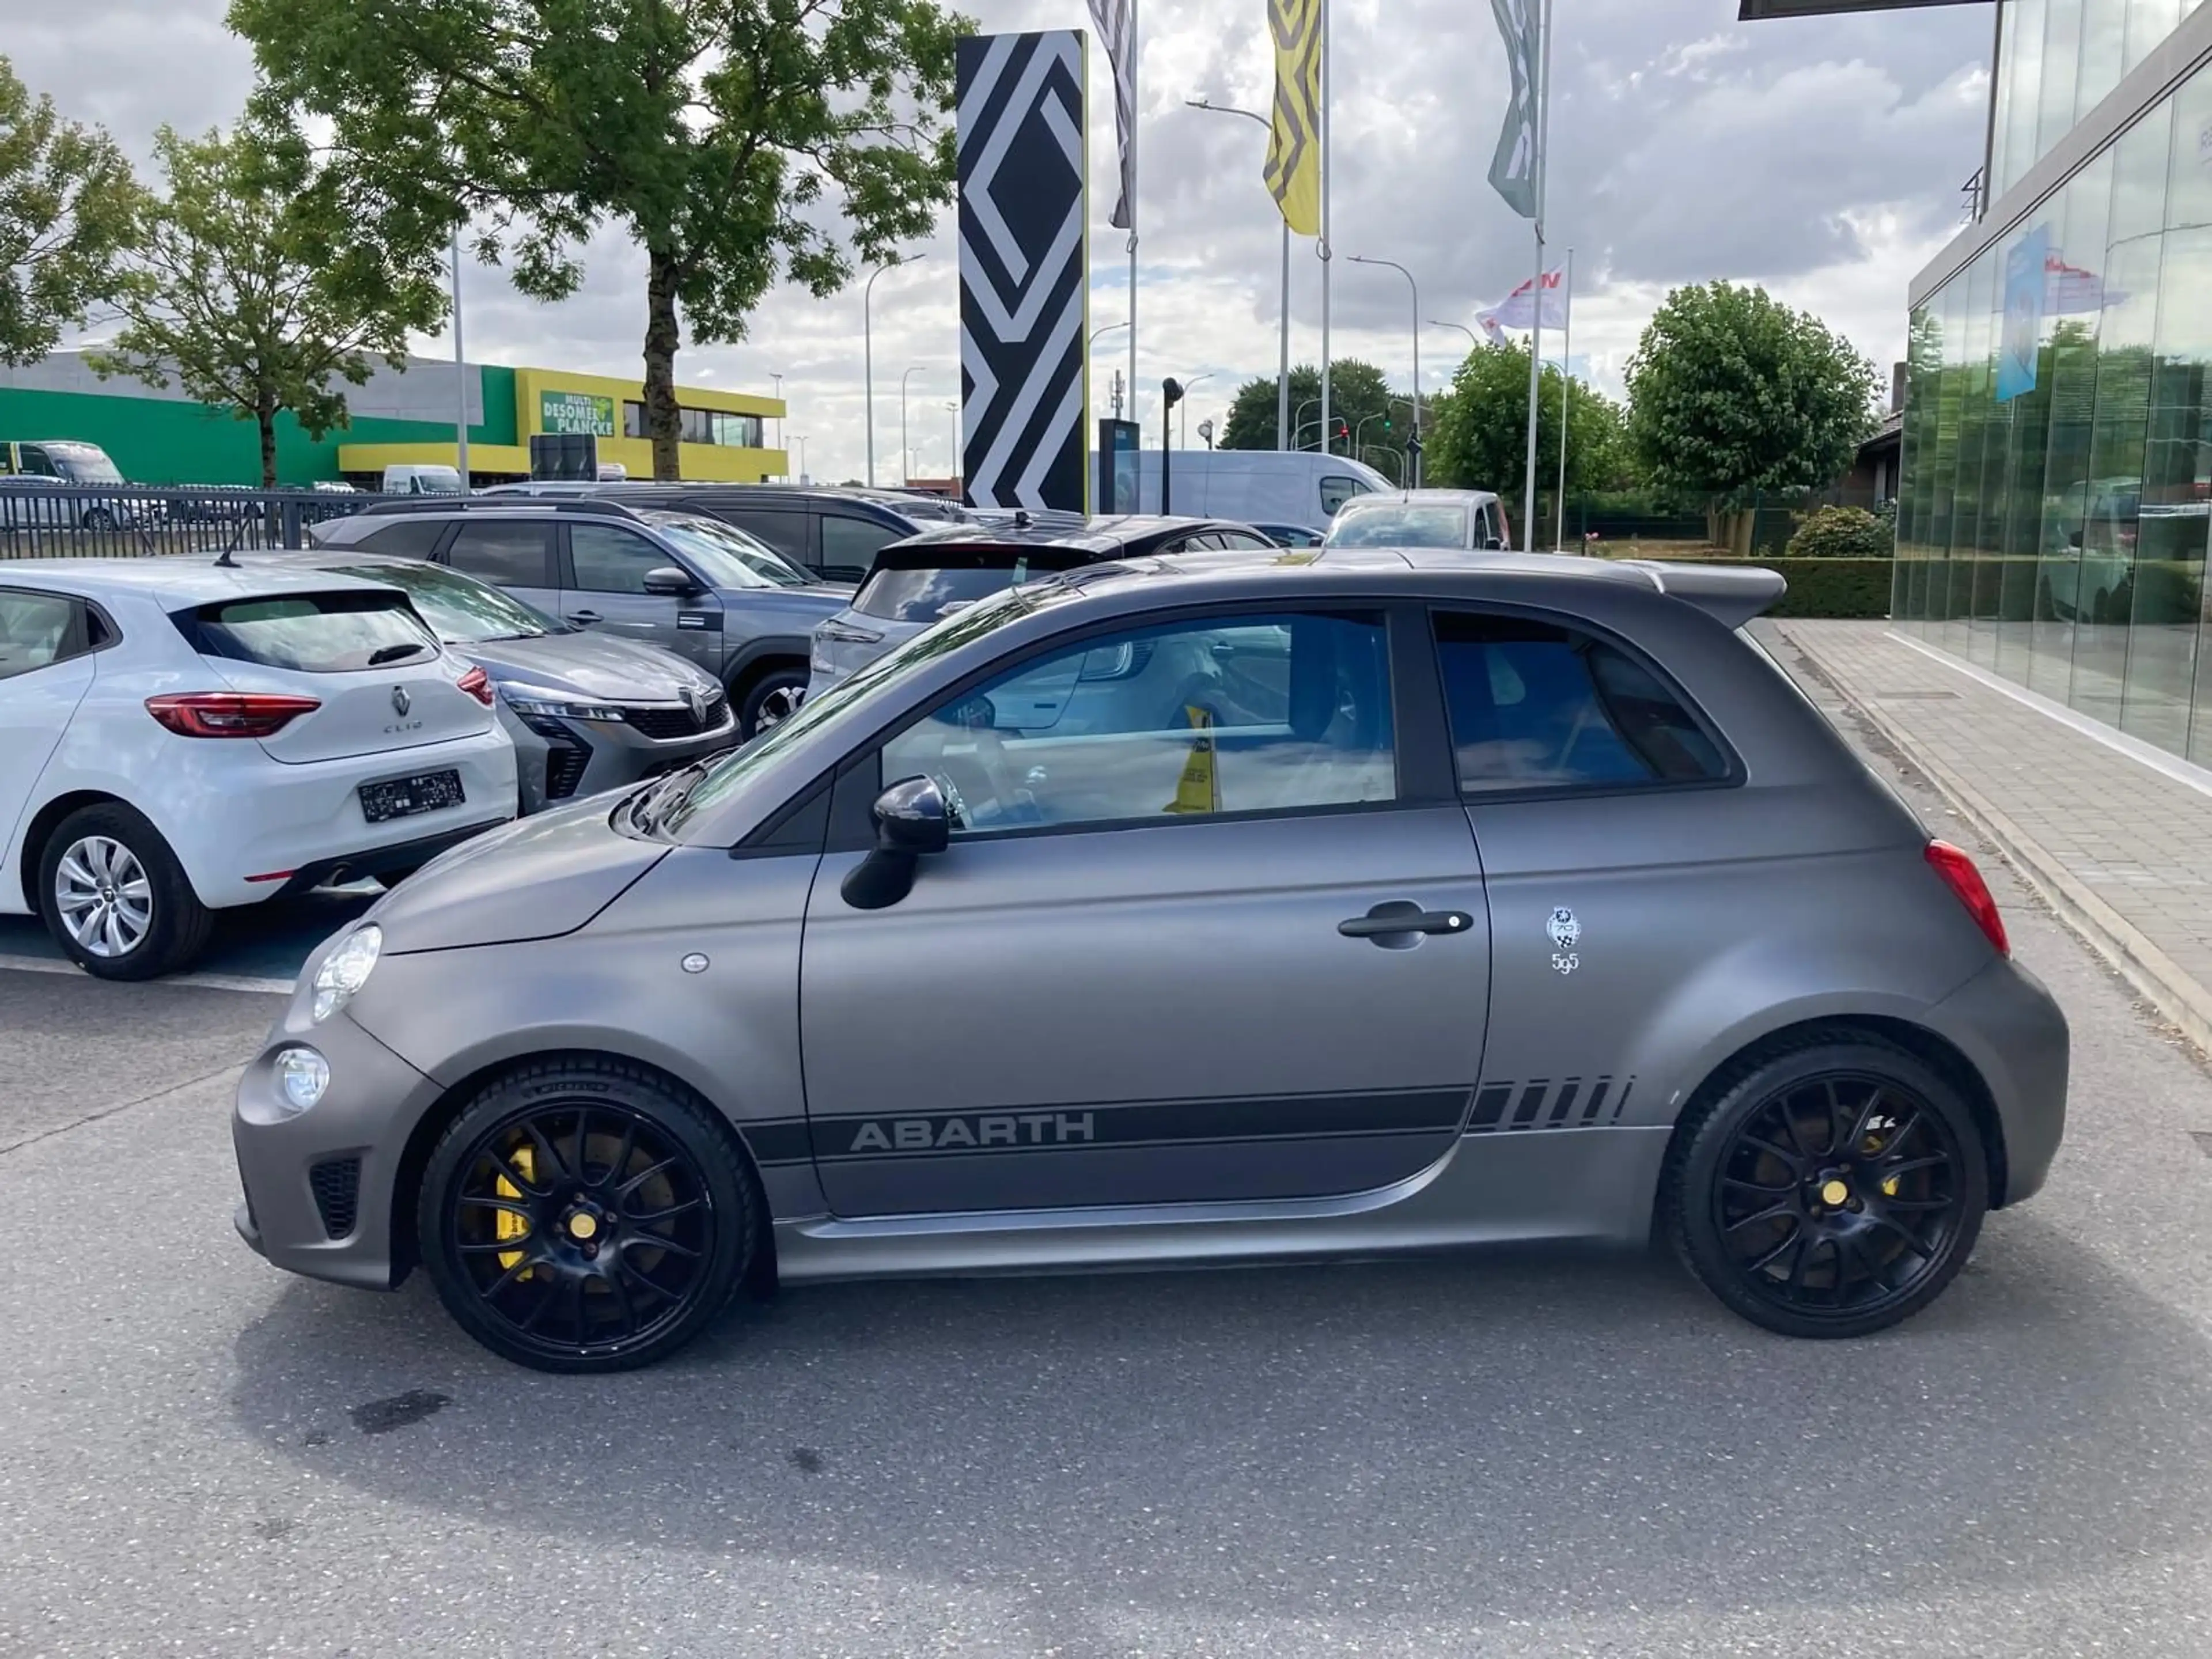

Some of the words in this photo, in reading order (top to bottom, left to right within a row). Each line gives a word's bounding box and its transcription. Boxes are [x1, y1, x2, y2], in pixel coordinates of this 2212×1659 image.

[558, 418, 613, 435] PLANCKE
[384, 721, 422, 733] CLIO
[1552, 952, 1579, 975] 595
[850, 1112, 1094, 1152] ABARTH
